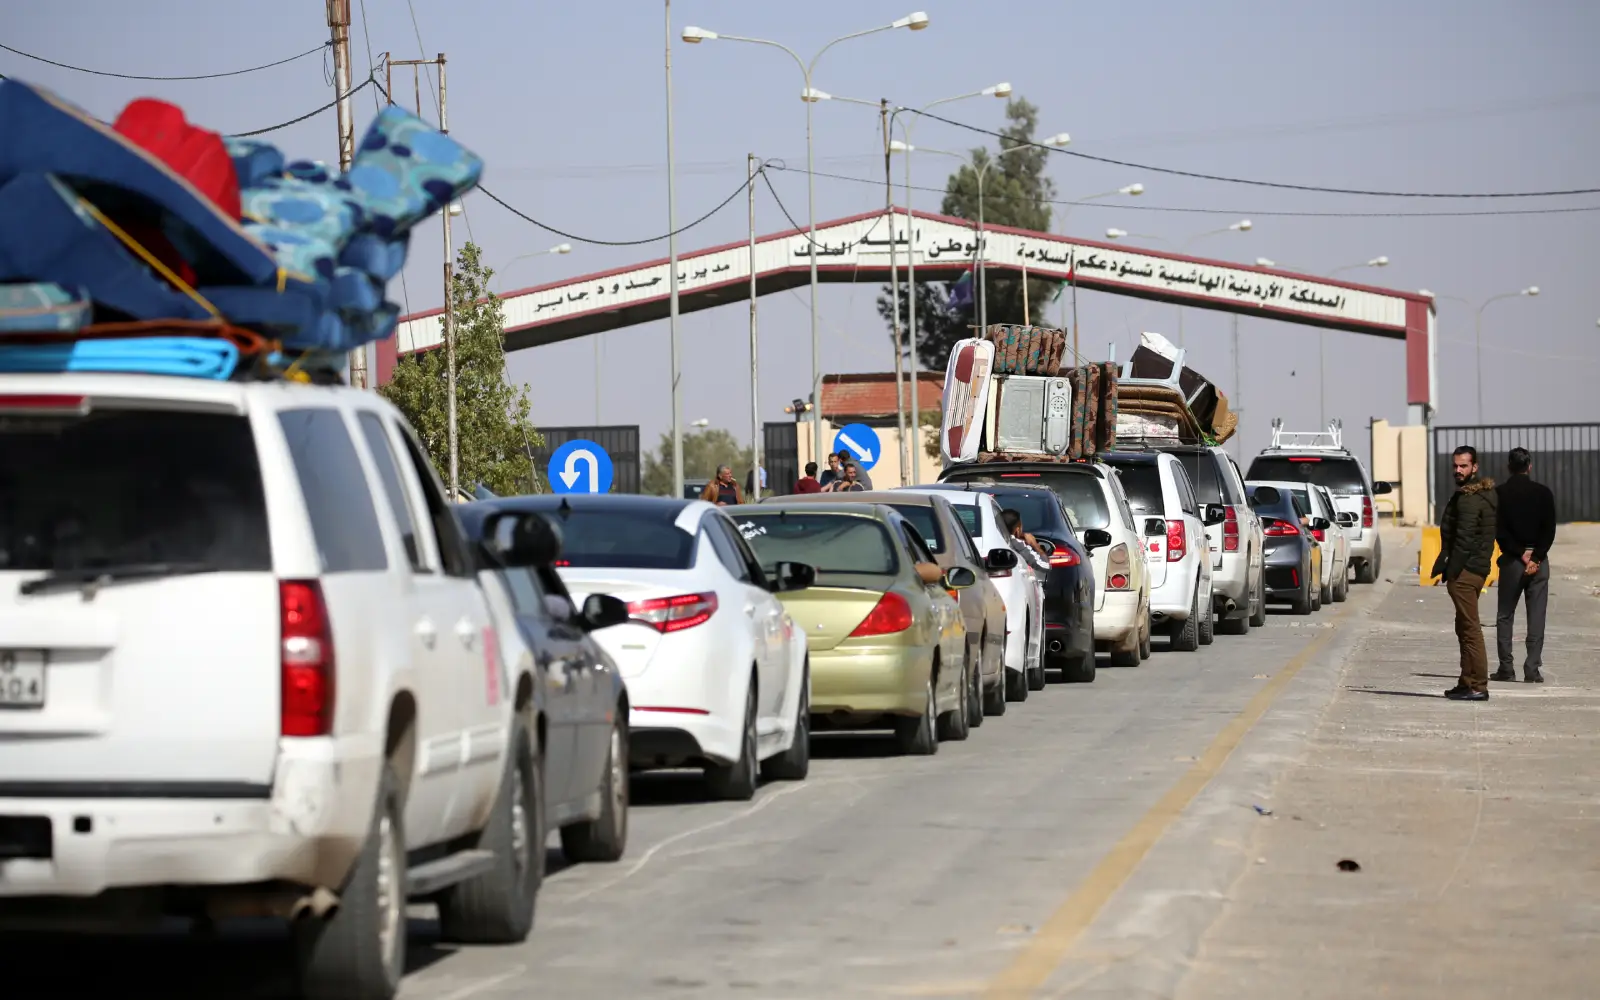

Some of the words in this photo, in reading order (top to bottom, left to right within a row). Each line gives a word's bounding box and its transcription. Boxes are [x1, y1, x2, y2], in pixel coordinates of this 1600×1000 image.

[860, 228, 920, 246] اله
[929, 236, 986, 258] الوطن
[794, 241, 851, 257] الملك
[1016, 242, 1074, 265] السلامة
[677, 264, 730, 284] مديري
[1075, 254, 1153, 278] تستودعكم
[597, 276, 662, 295] حدود
[1159, 265, 1226, 291] الهاشمية
[1228, 274, 1284, 300] الأردنية
[533, 291, 589, 313] جابر
[1289, 285, 1346, 310] المملكة
